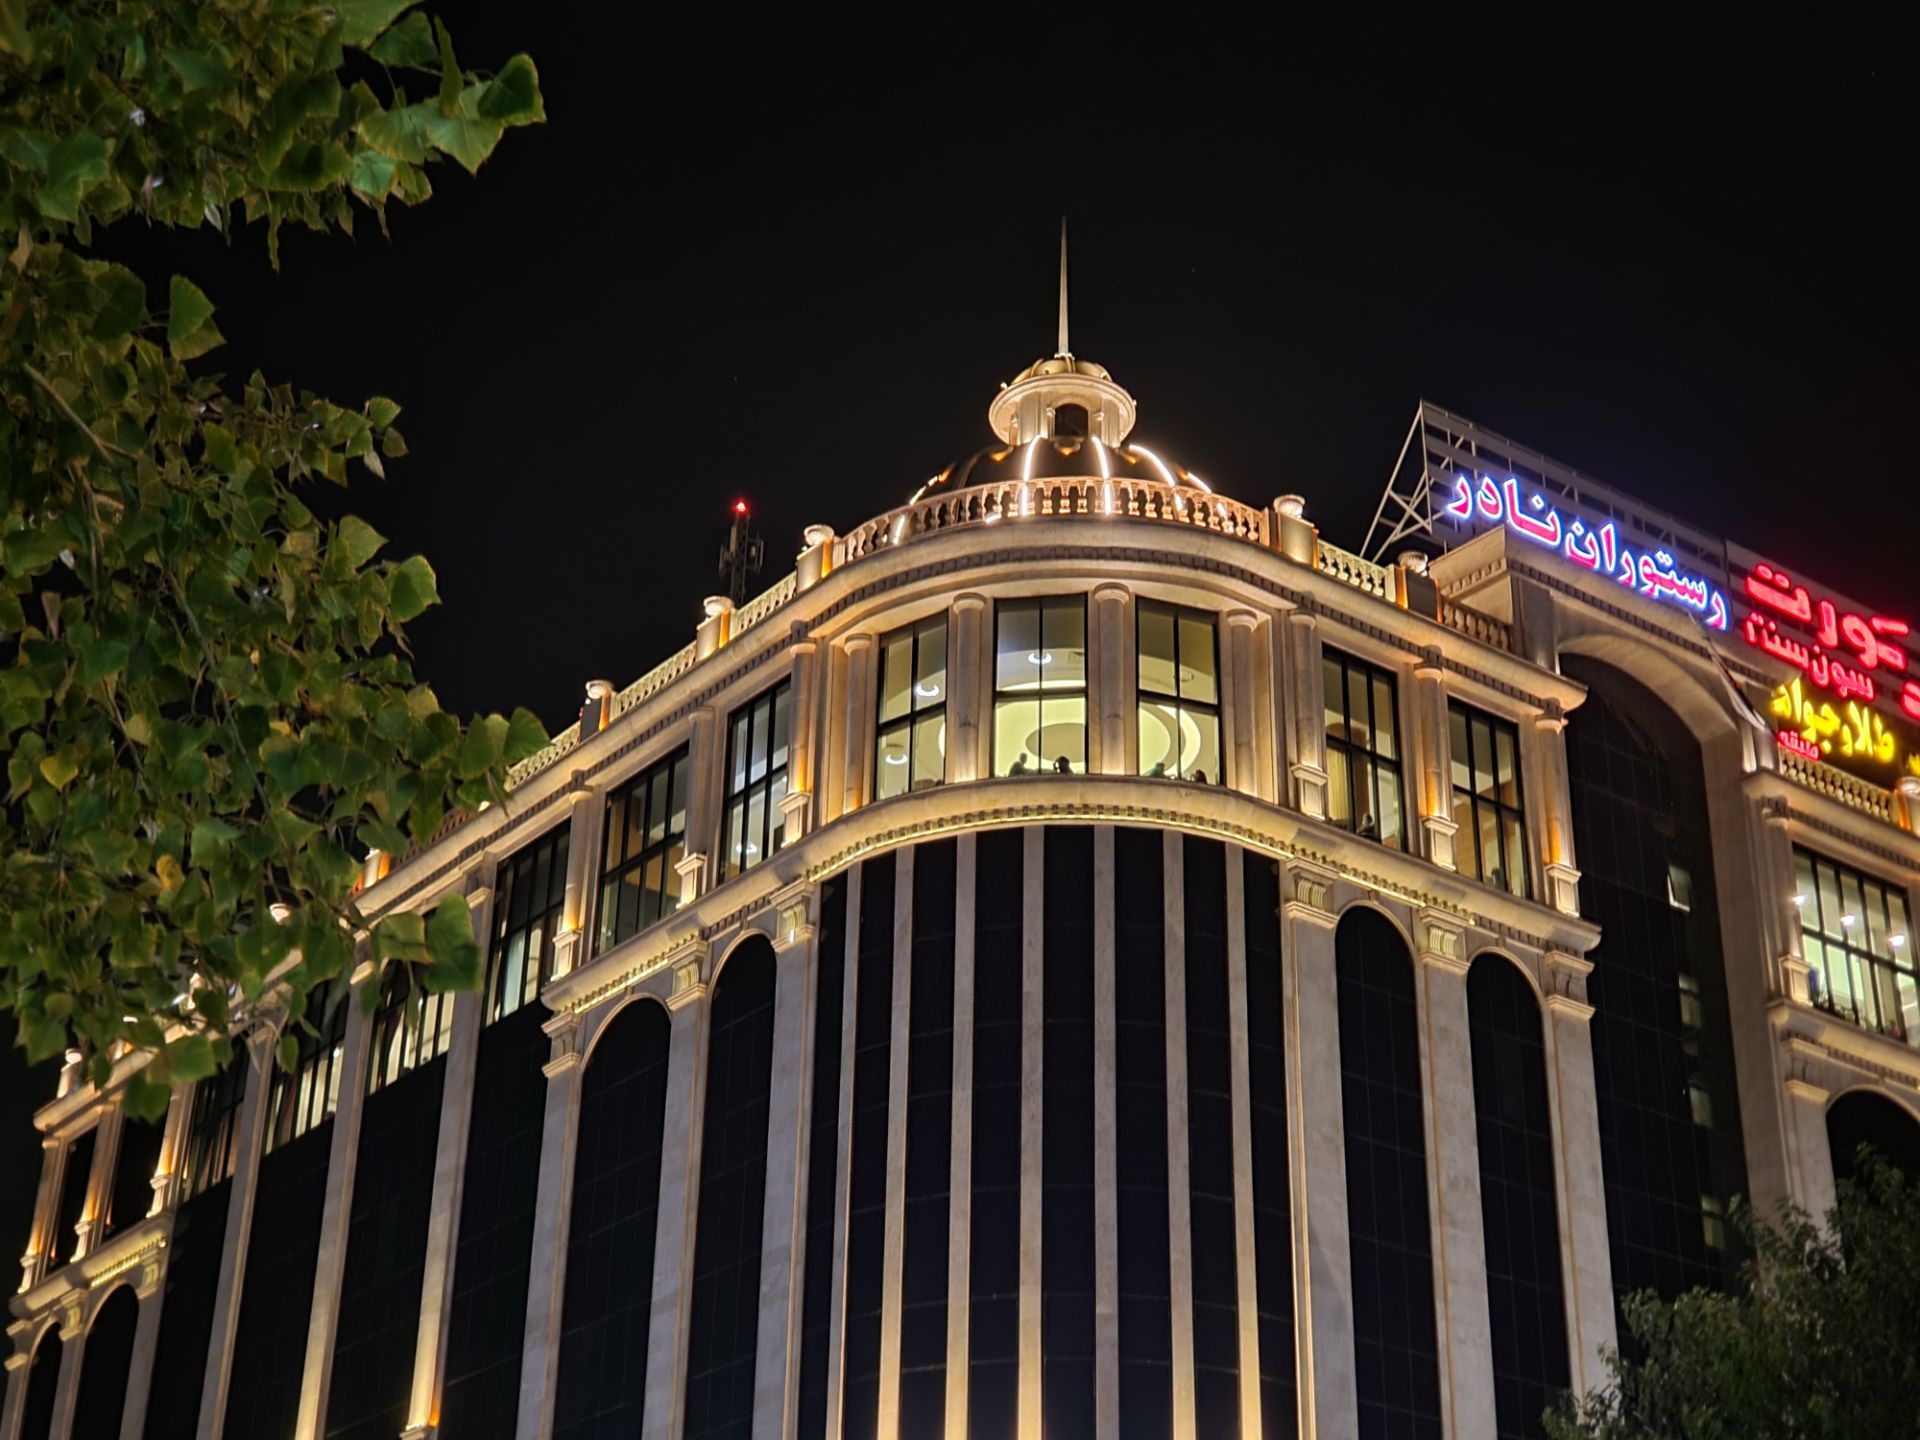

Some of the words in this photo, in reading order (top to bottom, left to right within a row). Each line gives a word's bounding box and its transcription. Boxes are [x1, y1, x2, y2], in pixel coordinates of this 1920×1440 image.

[1446, 475, 1562, 546] نادر
[1565, 518, 1728, 631] رستوران
[1840, 722, 1854, 757] و
[1847, 699, 1896, 764] طلا
